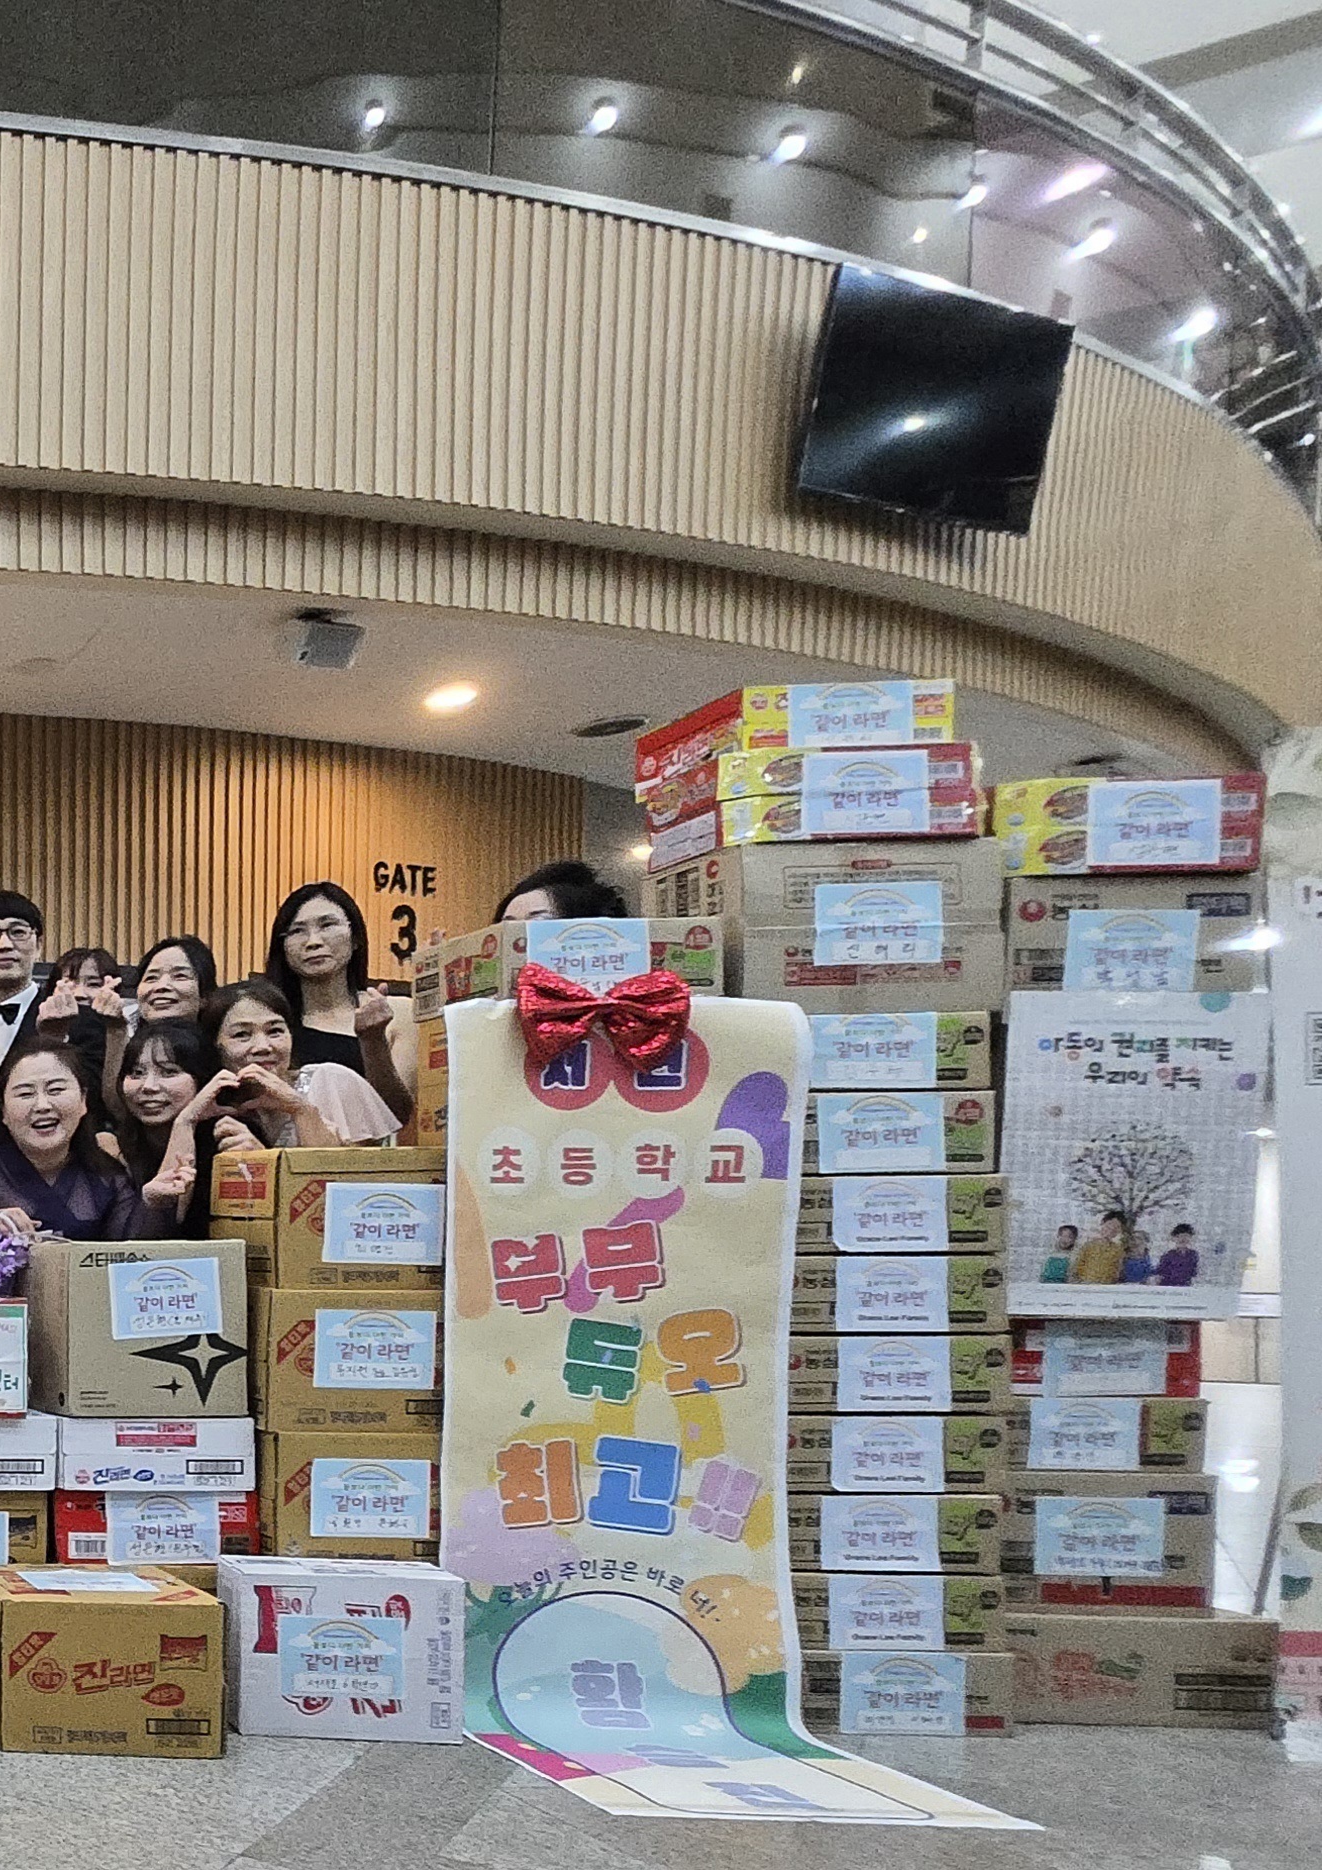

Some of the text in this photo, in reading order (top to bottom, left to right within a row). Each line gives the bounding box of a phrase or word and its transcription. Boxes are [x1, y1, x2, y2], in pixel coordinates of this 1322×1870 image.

[373, 861, 437, 897] GATE
[390, 904, 417, 966] 3
[1084, 1062, 1148, 1085] 우리의
[490, 1143, 747, 1186] 초등학교
[558, 1559, 639, 1580] 주인공은
[646, 1567, 685, 1596] 바로
[72, 1659, 156, 1696] 진라면
